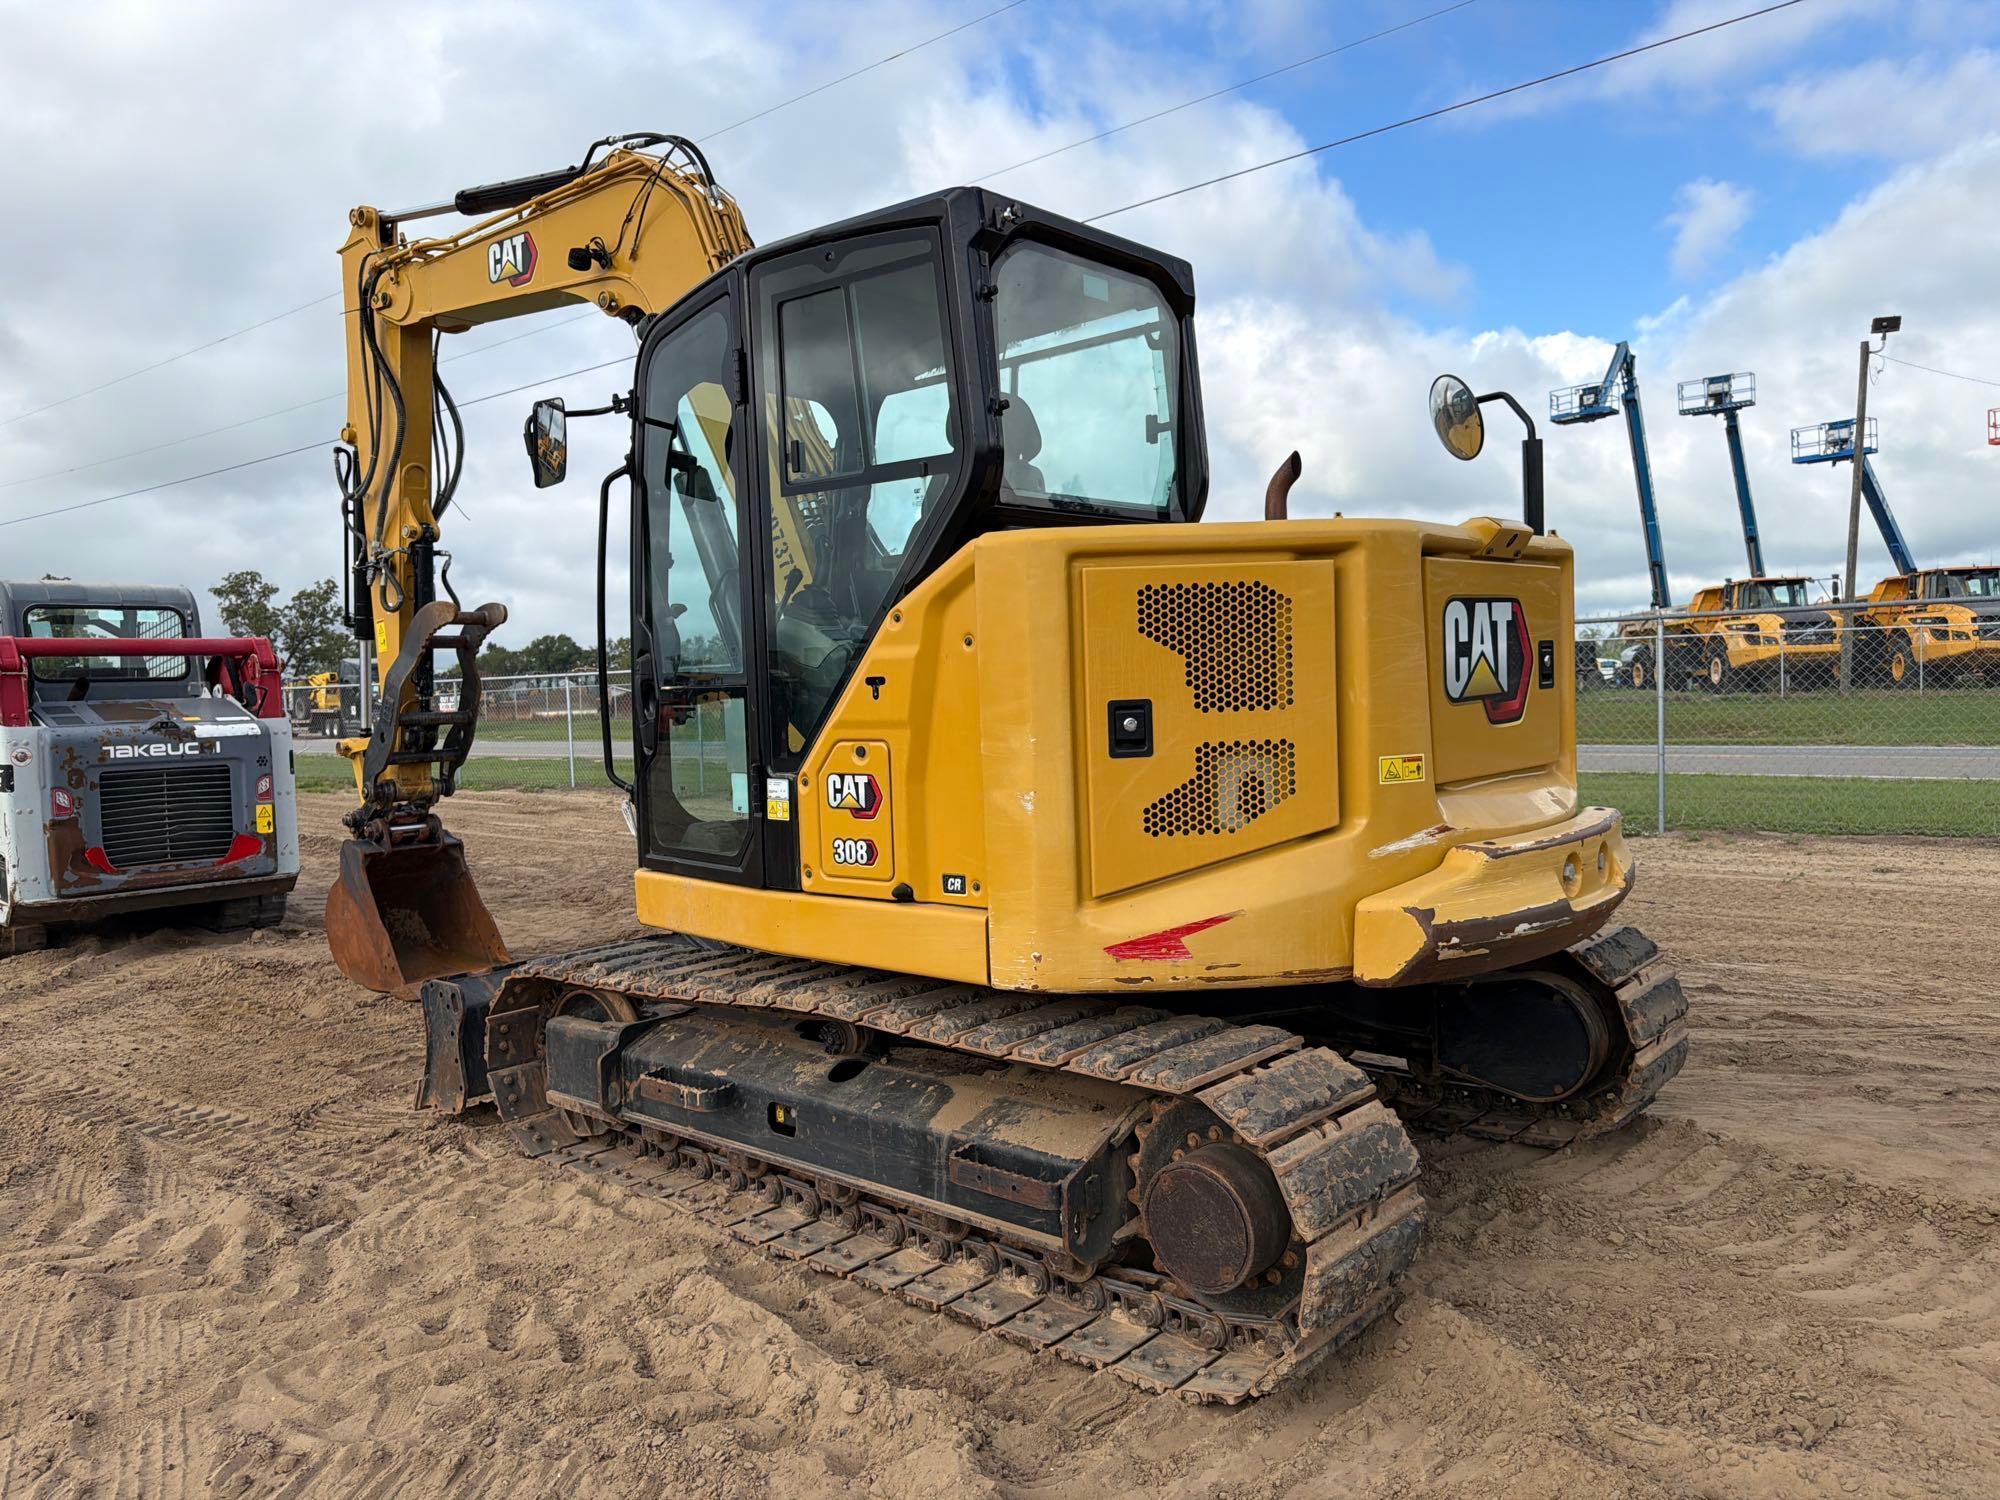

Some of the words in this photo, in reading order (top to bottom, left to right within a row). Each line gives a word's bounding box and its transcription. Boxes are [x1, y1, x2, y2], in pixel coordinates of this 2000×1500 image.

[488, 233, 525, 283] CAT
[1444, 600, 1513, 699] CAT
[102, 740, 221, 759] TAKEUCI
[827, 774, 868, 809] CAT
[833, 839, 868, 865] 308
[947, 877, 962, 891] CR
